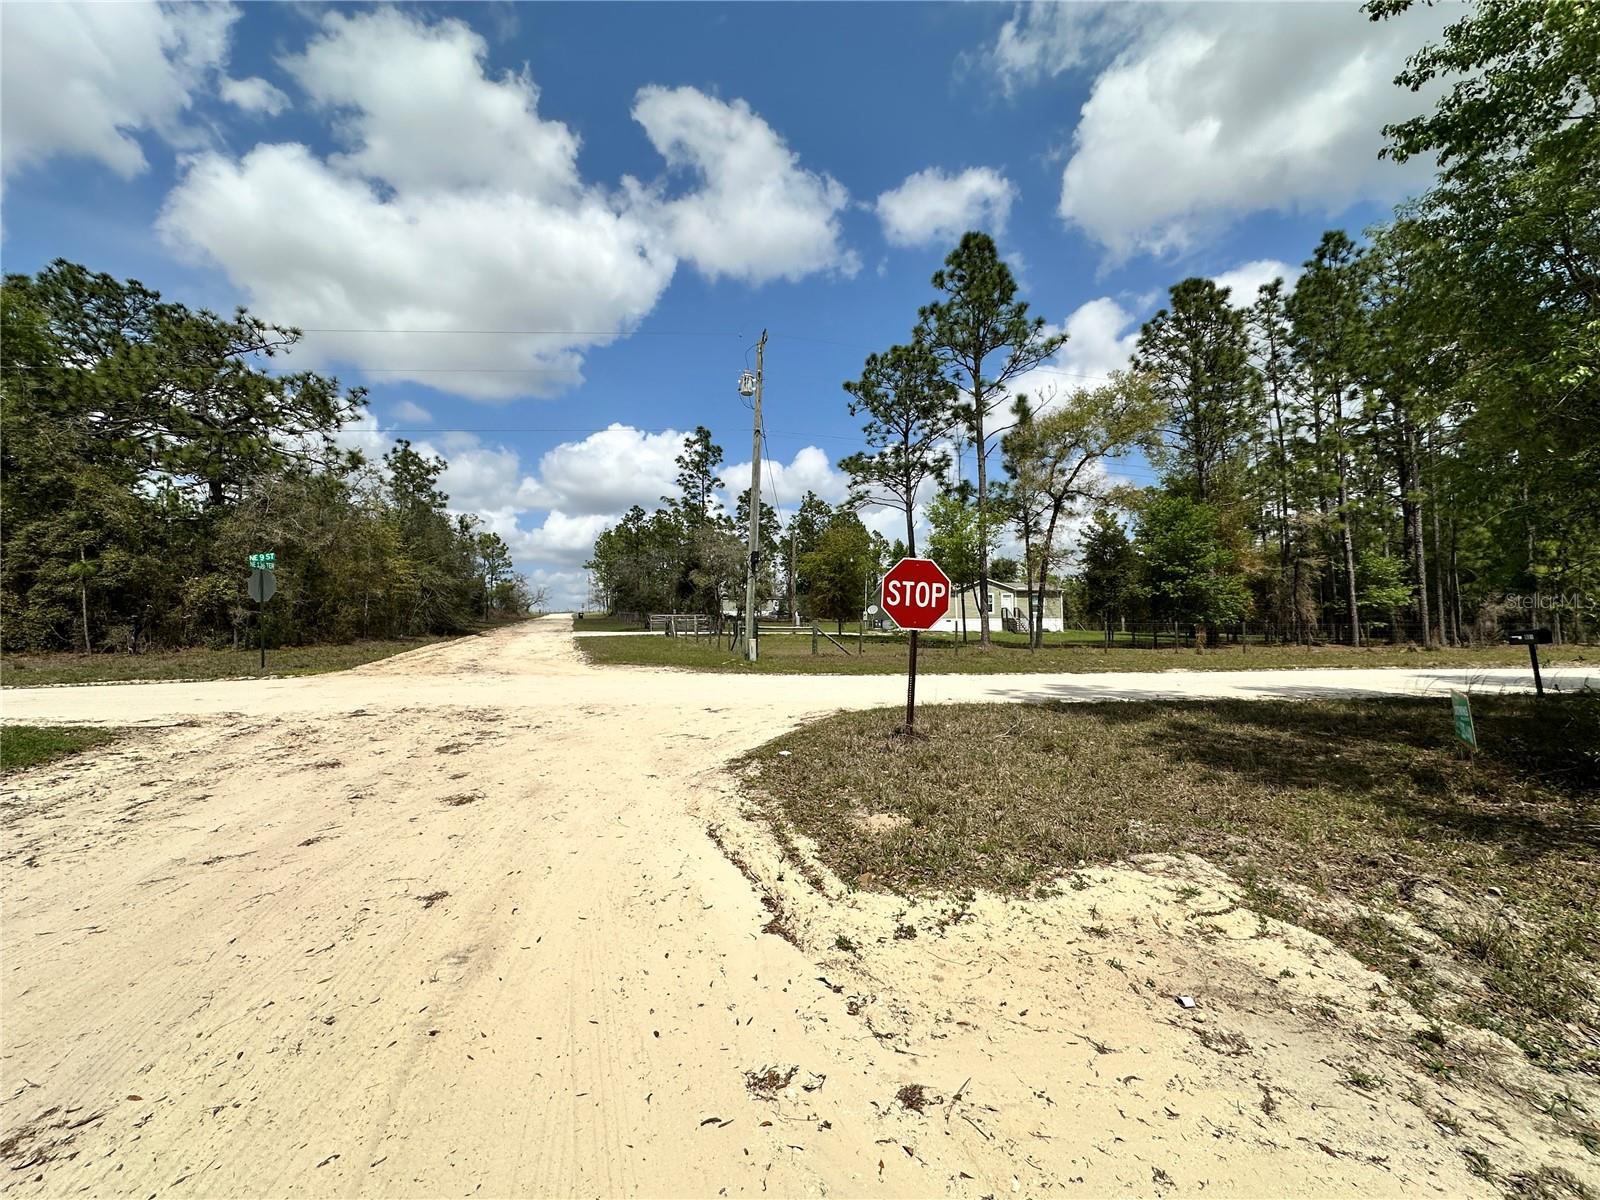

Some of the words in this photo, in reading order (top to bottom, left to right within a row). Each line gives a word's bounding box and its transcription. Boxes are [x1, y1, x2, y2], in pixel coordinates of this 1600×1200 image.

[260, 553, 264, 561] 9
[266, 552, 275, 560] ST
[886, 580, 946, 608] STOP
